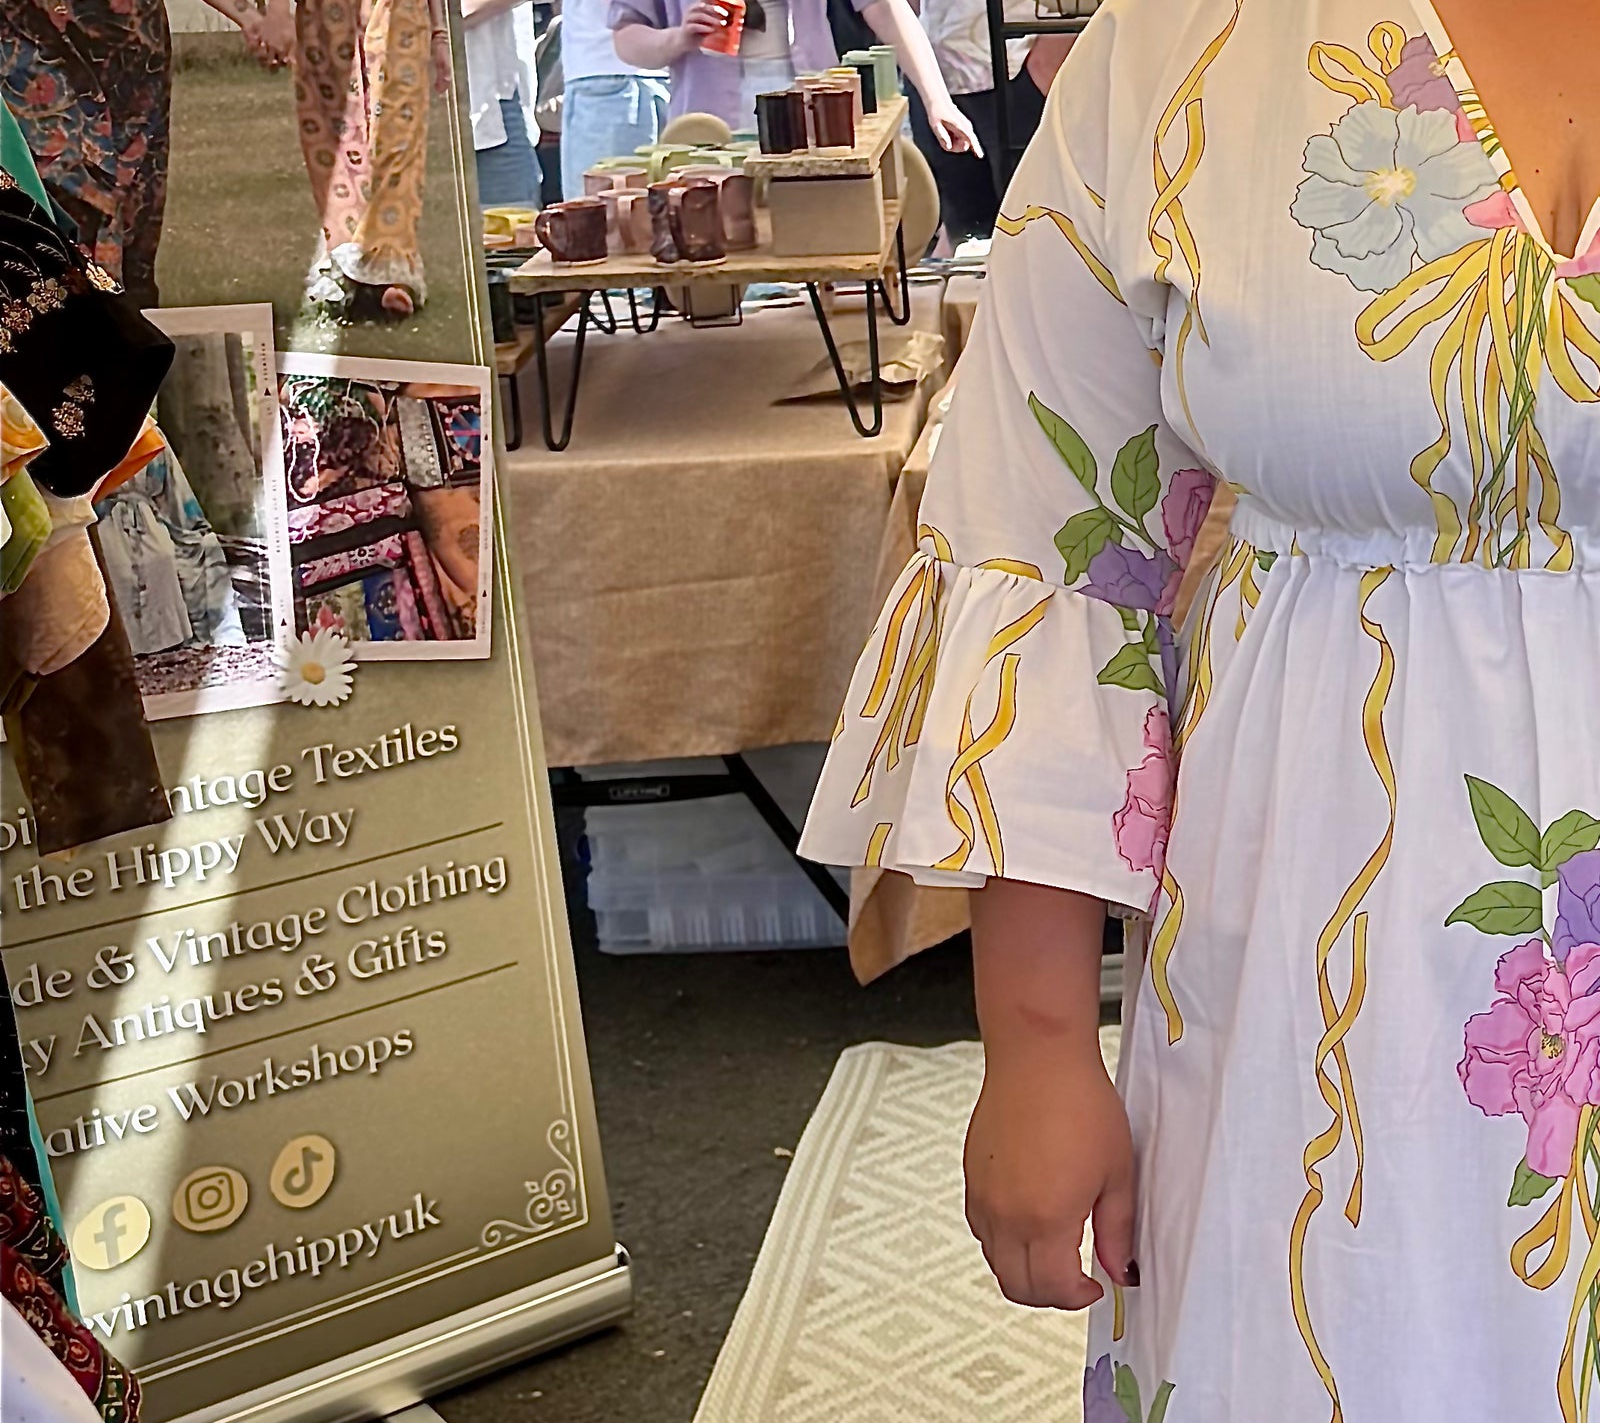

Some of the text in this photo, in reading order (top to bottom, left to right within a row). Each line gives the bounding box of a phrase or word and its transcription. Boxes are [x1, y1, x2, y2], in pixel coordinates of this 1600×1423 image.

[301, 722, 459, 785] Textiles
[14, 807, 356, 911] the Hippy Way
[13, 855, 507, 1008] de & Vintage Clothing
[73, 974, 284, 1058] Antiques
[293, 953, 338, 998] &
[346, 924, 448, 980] Gifts
[44, 1026, 416, 1158] ative Workshops
[83, 1191, 441, 1340] vintagehippyuk
